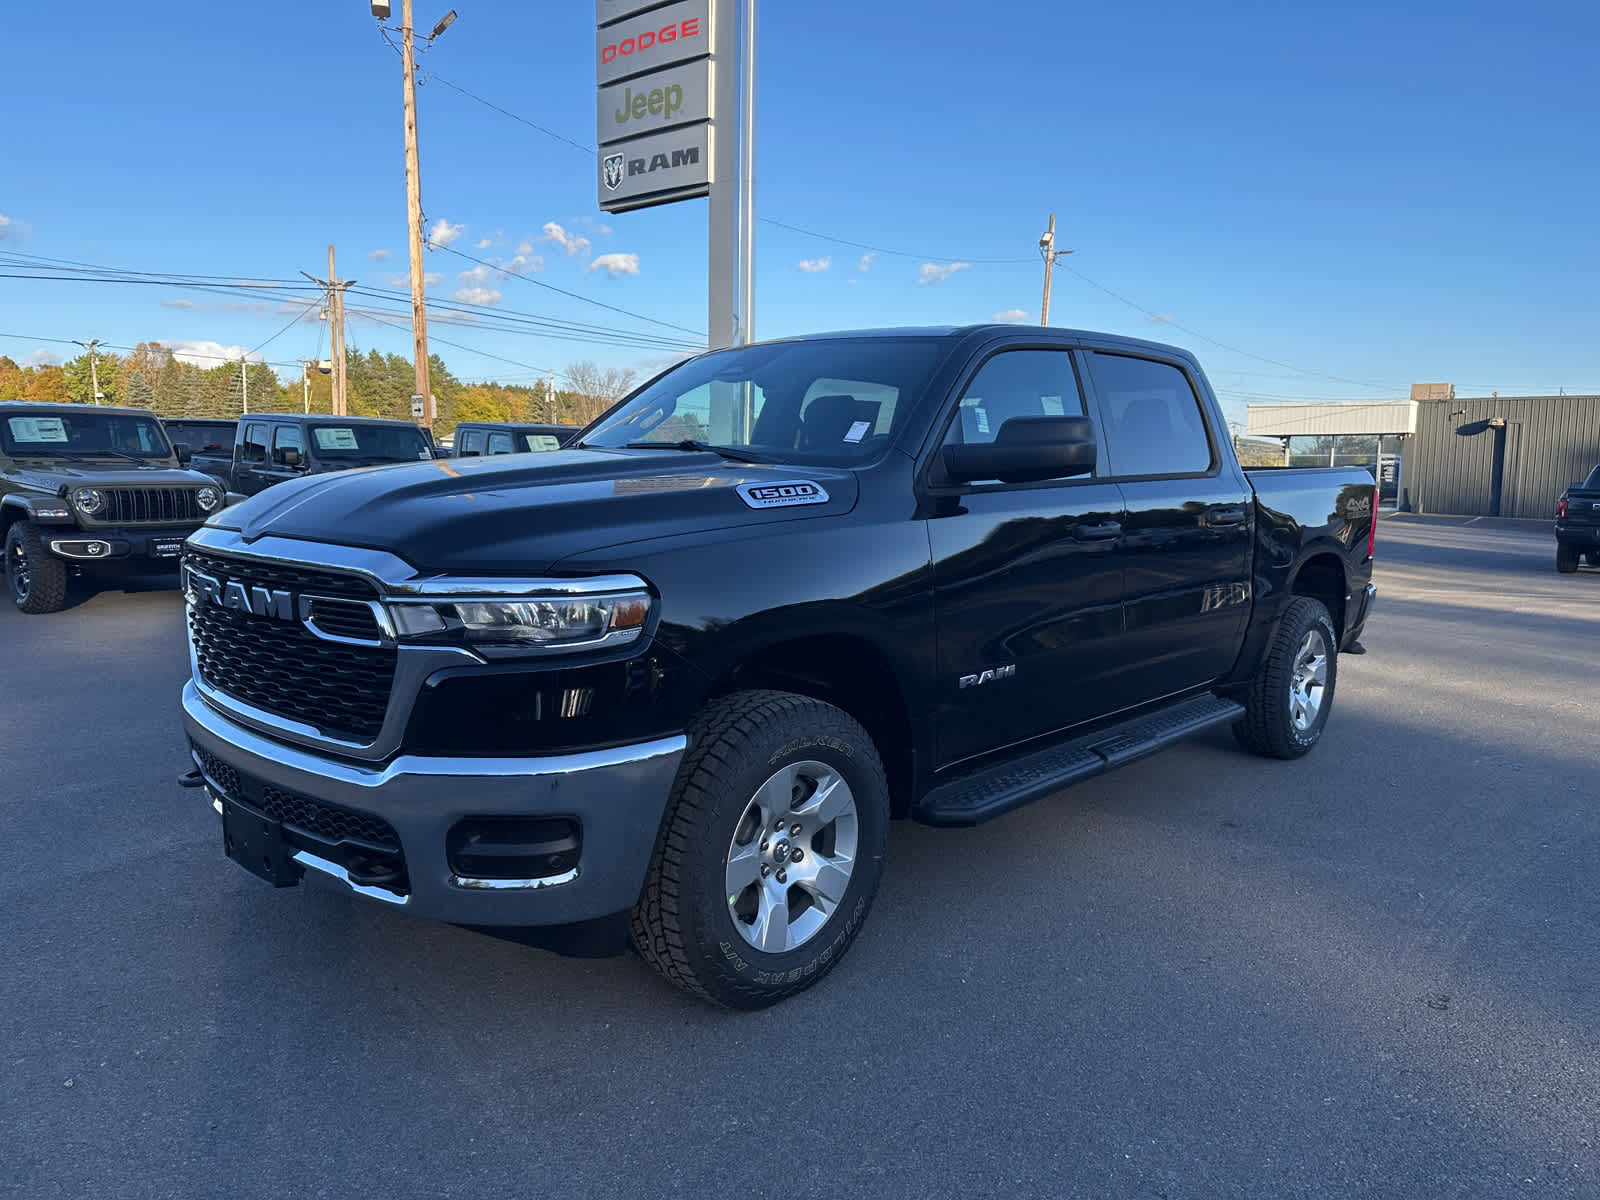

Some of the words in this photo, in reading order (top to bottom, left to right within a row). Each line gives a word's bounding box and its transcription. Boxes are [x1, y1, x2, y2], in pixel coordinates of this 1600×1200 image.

[601, 18, 700, 64] DODGE
[615, 84, 683, 123] Jeep
[628, 147, 700, 177] RAM
[751, 485, 813, 499] 1500
[196, 573, 293, 620] RAM
[959, 664, 1016, 689] RAM
